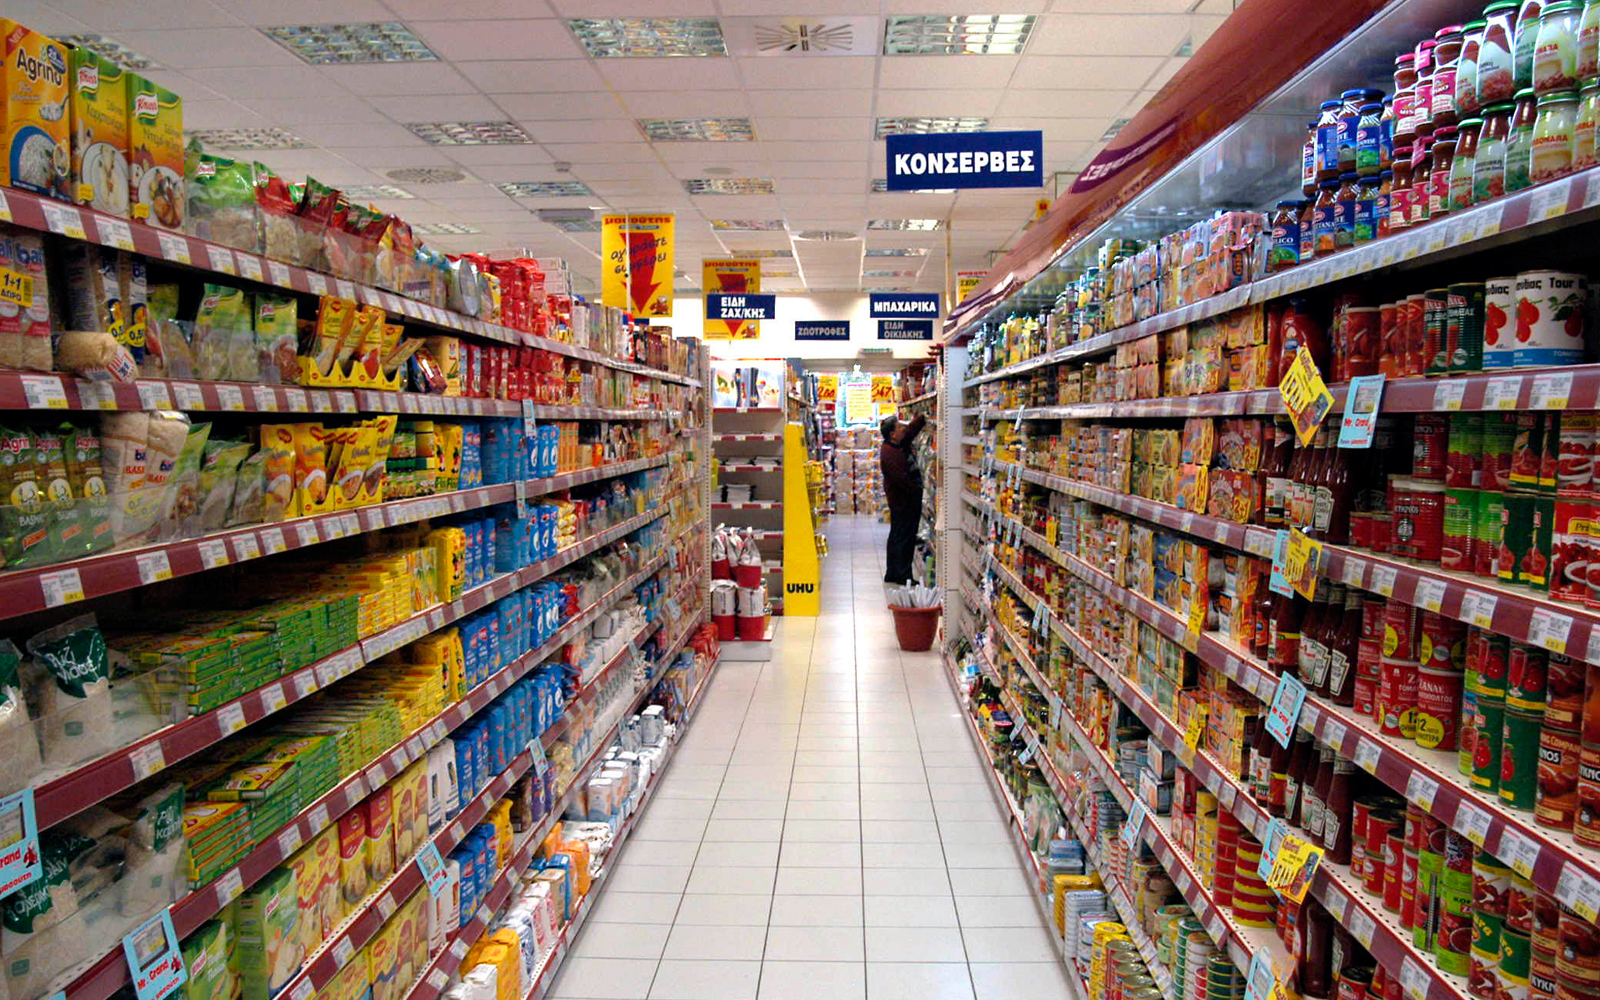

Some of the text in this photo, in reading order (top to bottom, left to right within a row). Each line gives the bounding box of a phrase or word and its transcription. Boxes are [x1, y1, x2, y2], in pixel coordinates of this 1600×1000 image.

[17, 48, 62, 86] Agrino
[895, 150, 1035, 175] ΚΟΝΣΕΡΒΕΣ
[4, 274, 22, 290] 1+1
[721, 297, 746, 307] ΕΙΔΗ
[874, 301, 936, 312] ΜΠΑΧΑΡΙΚΑ
[721, 308, 766, 319] ΖΑΧ/ΚΗΣ
[884, 322, 904, 330] ΕΙΔΗ
[884, 331, 925, 339] ΟΙΚΙΑΚΗΣ
[787, 583, 814, 593] UHU
